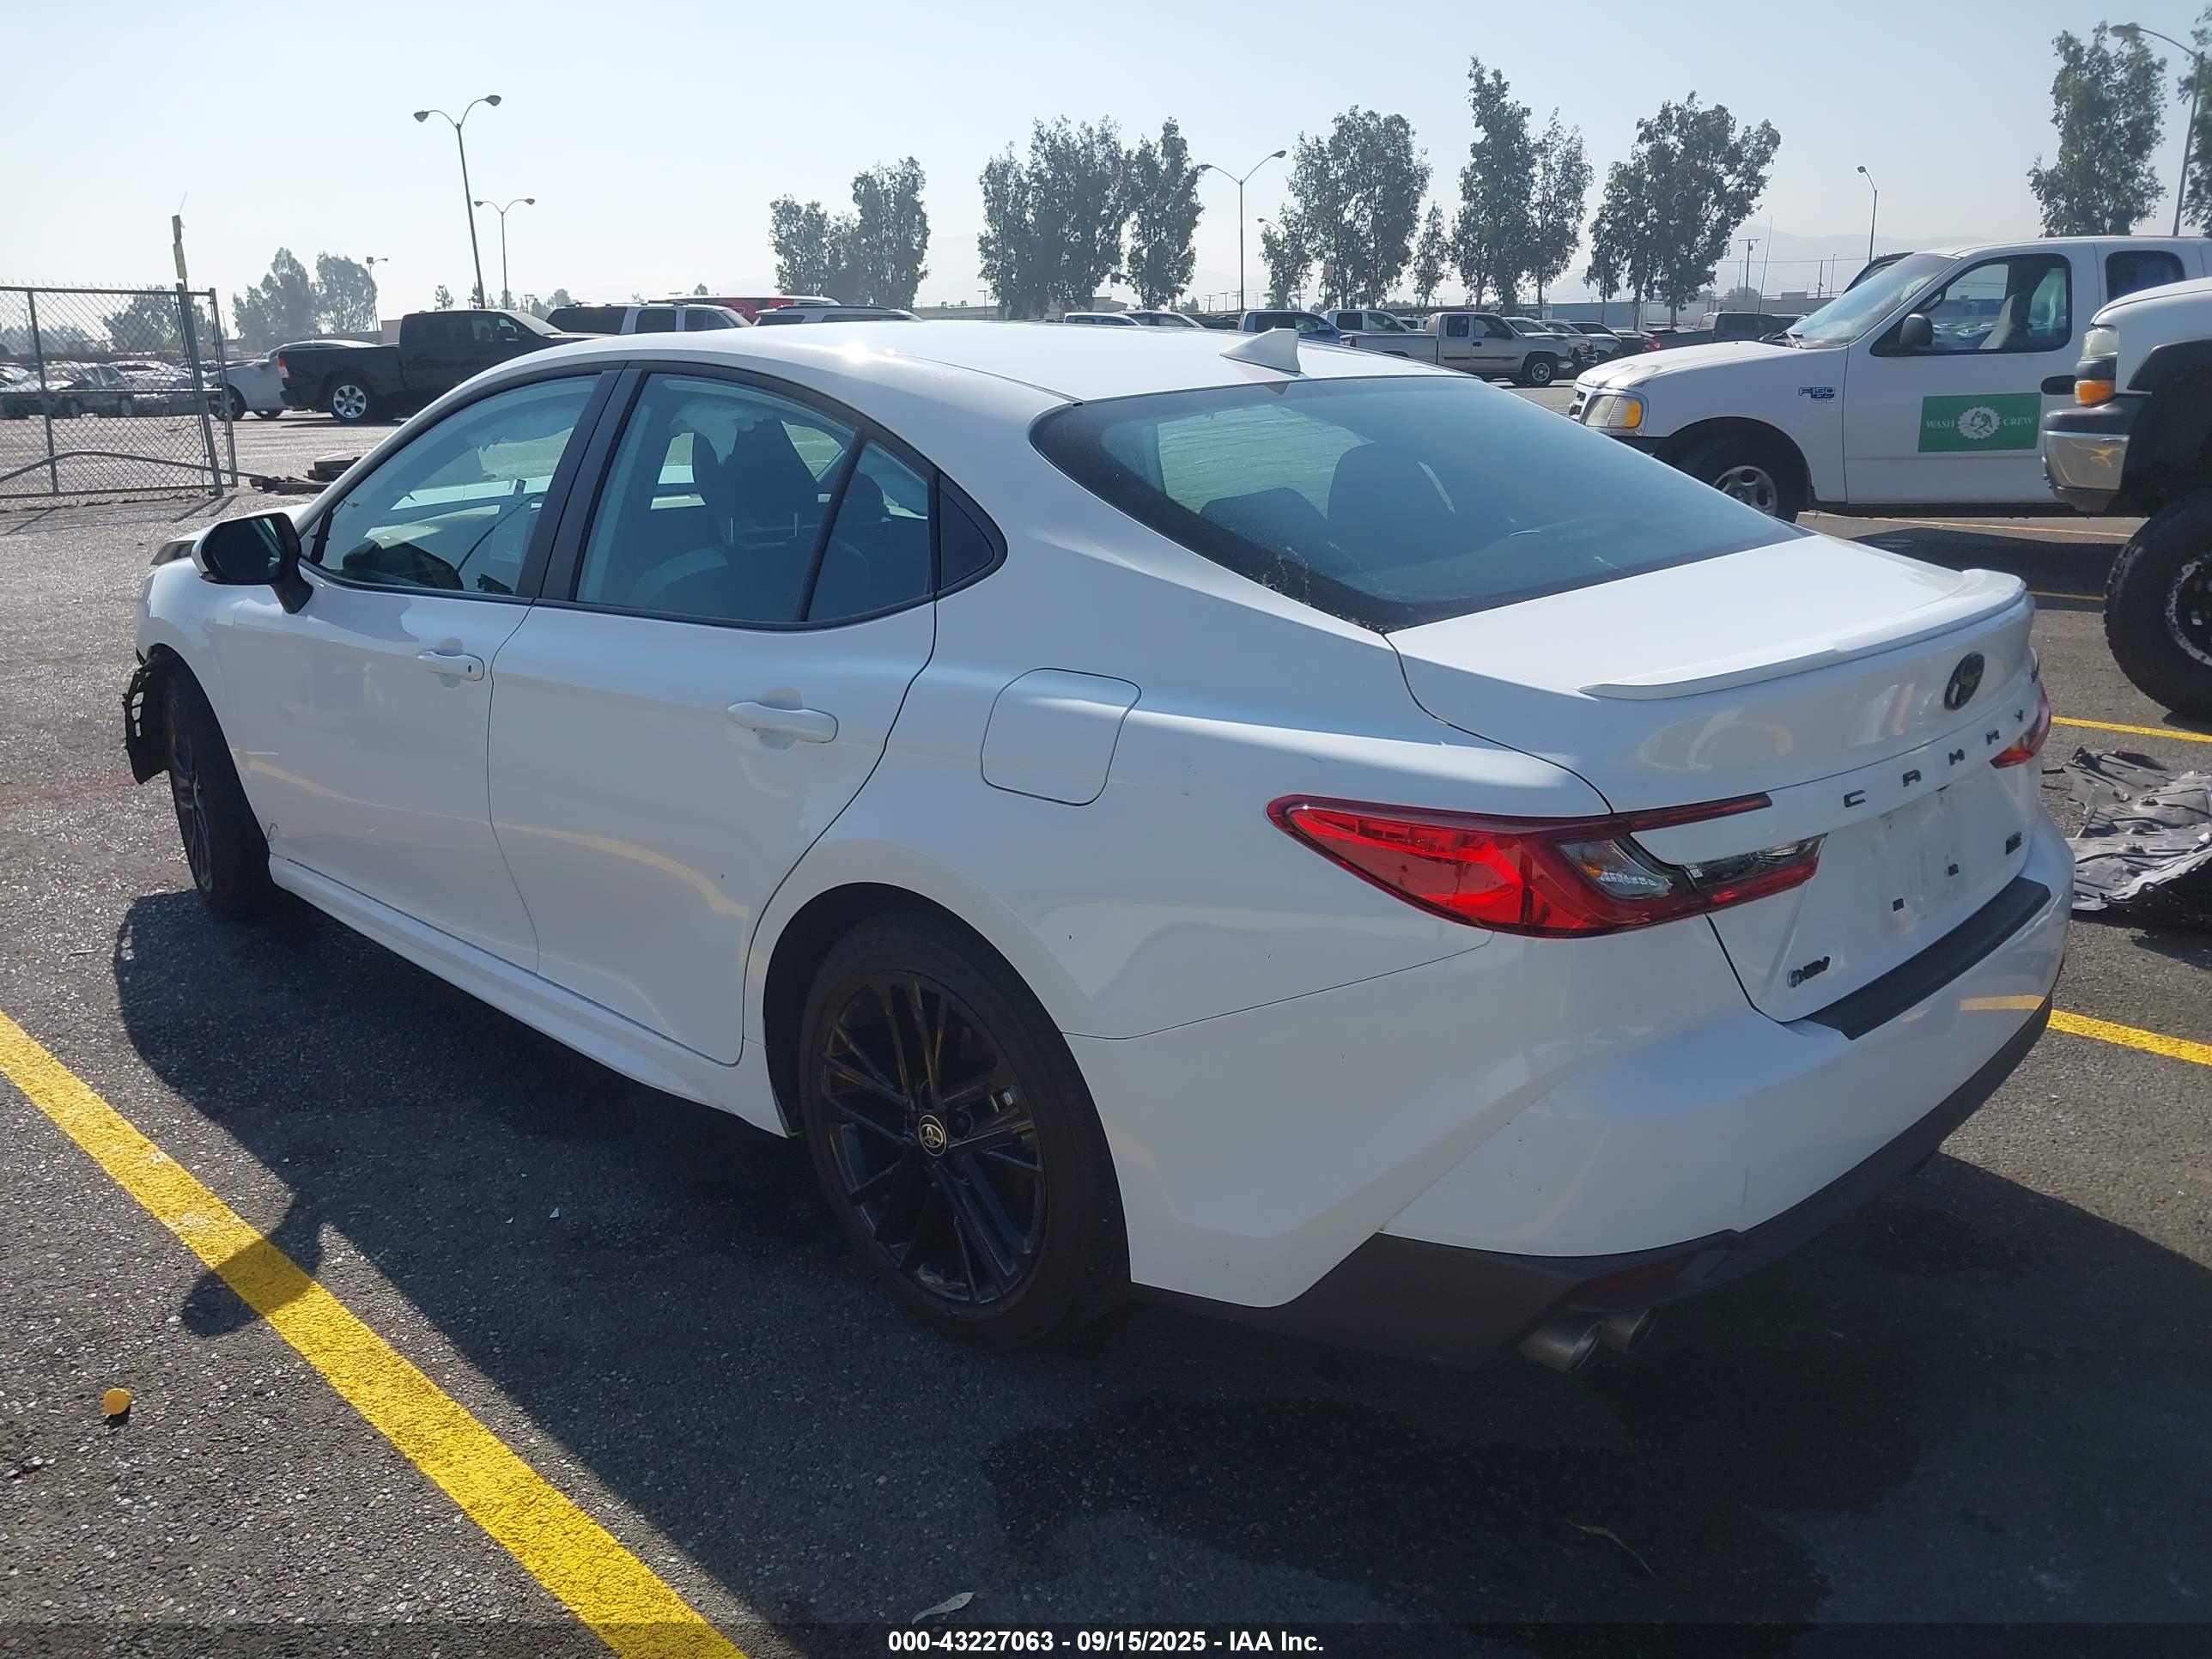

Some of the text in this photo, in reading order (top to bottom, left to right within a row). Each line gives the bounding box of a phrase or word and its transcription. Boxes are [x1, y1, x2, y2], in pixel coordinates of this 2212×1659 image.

[1925, 416, 2034, 428] WASH CREW
[1844, 709, 2024, 808] CAMRY
